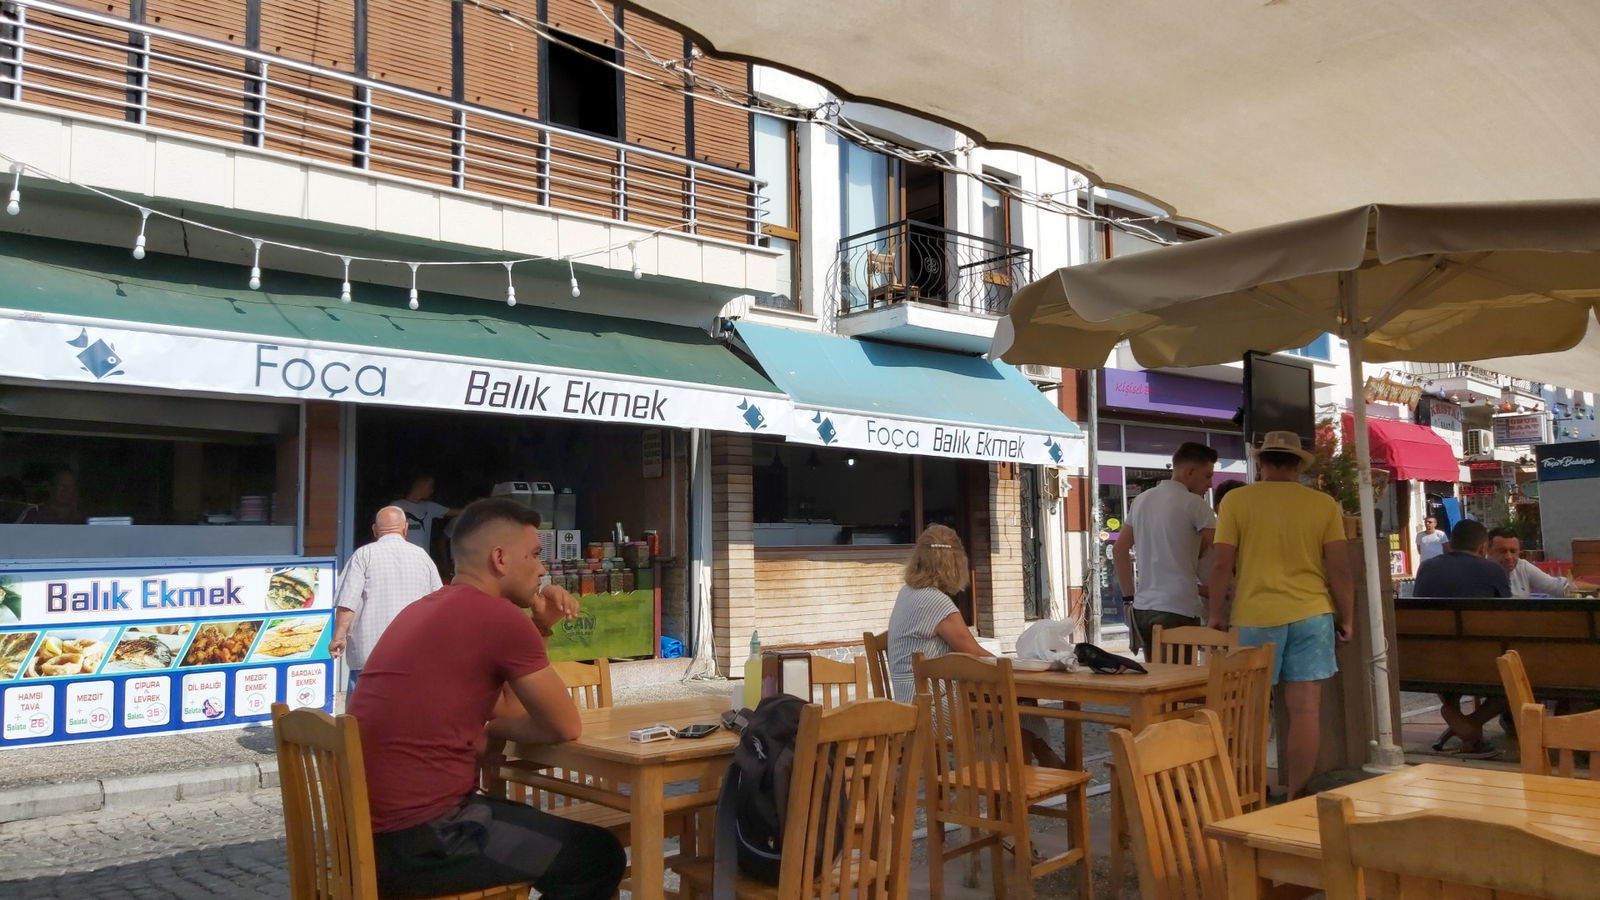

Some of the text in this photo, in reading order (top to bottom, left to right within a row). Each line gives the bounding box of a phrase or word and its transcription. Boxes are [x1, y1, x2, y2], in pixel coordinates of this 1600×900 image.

[254, 344, 669, 422] Foça Balık Ekmek
[867, 420, 1025, 459] Foça Balık Ekmek
[46, 576, 244, 614] Balık Ekmek
[291, 668, 322, 678] SARDALYA
[295, 678, 317, 687] EKMEK
[245, 684, 267, 692] EKMEK
[133, 694, 161, 703] LEVREK
[20, 703, 40, 712] TAVA
[146, 707, 160, 718] 35
[69, 713, 105, 726] Salata 30
[6, 723, 27, 732] Salata
